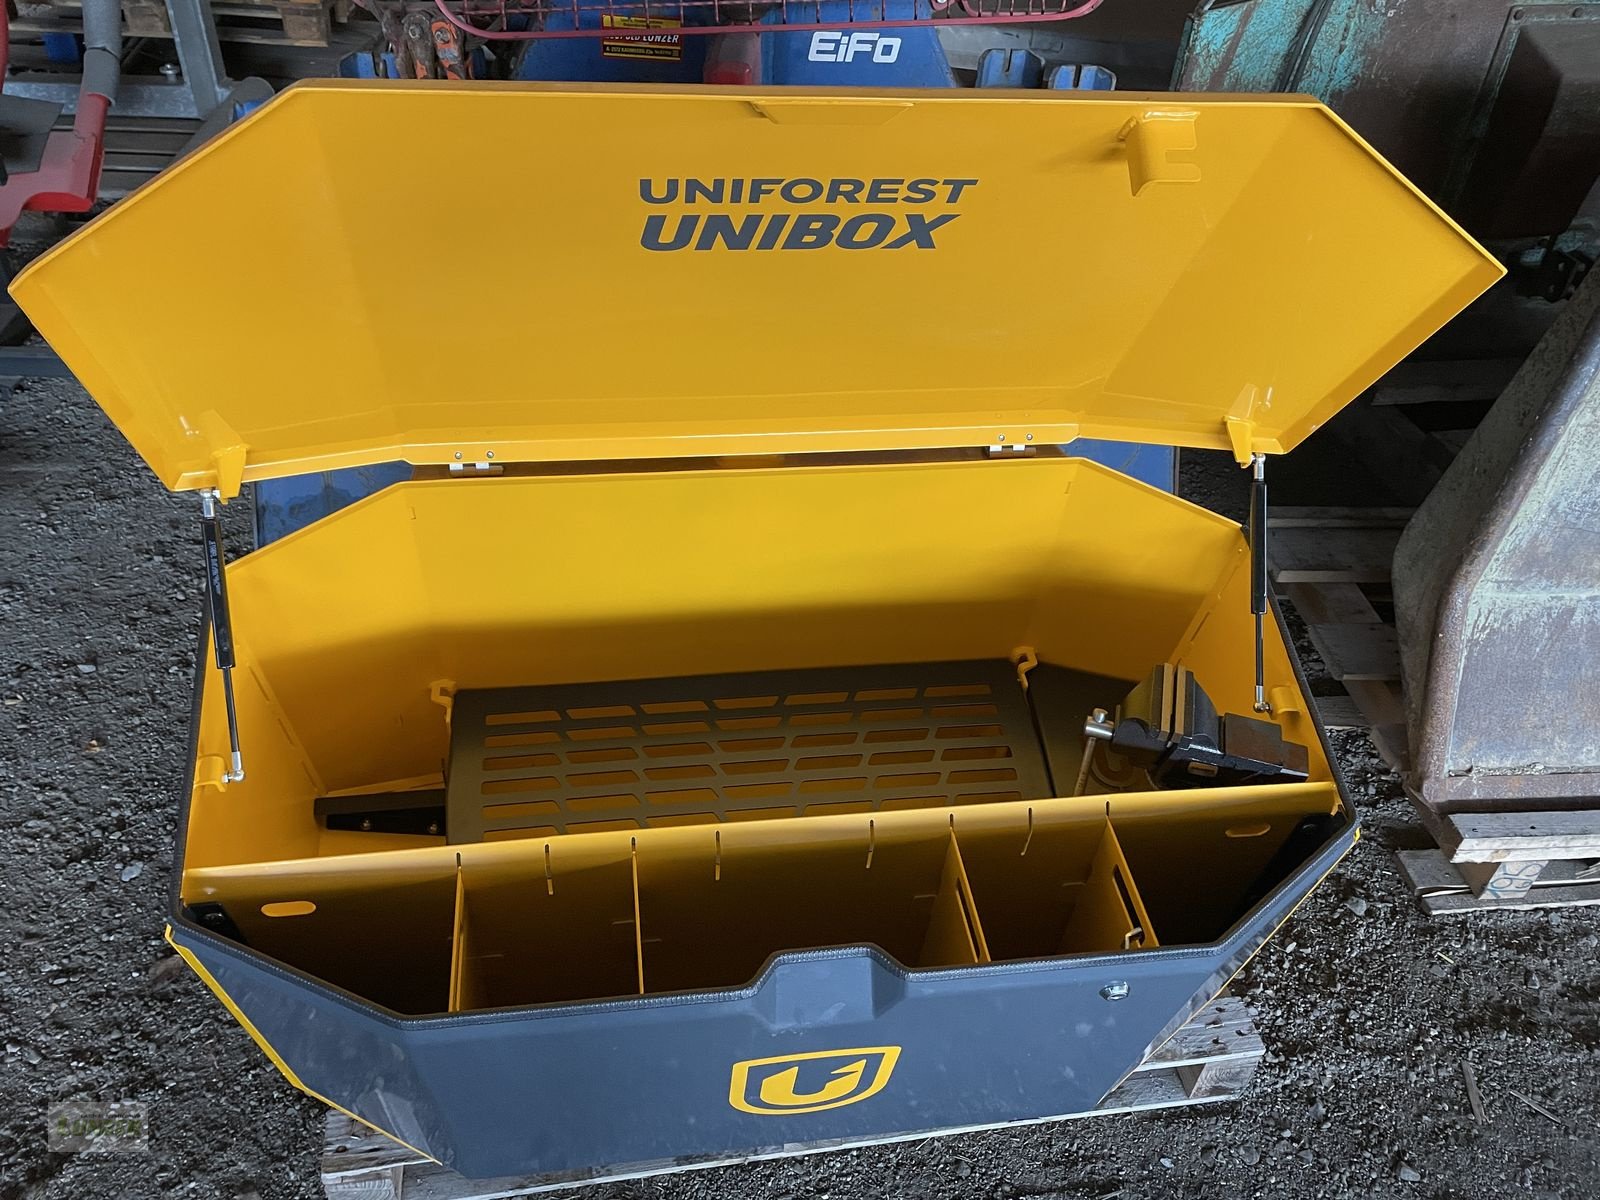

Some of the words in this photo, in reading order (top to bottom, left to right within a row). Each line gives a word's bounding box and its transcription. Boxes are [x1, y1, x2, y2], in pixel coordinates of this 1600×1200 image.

[807, 31, 901, 64] EiFo
[639, 178, 979, 204] UNIFOREST
[640, 213, 962, 251] UNIBOX
